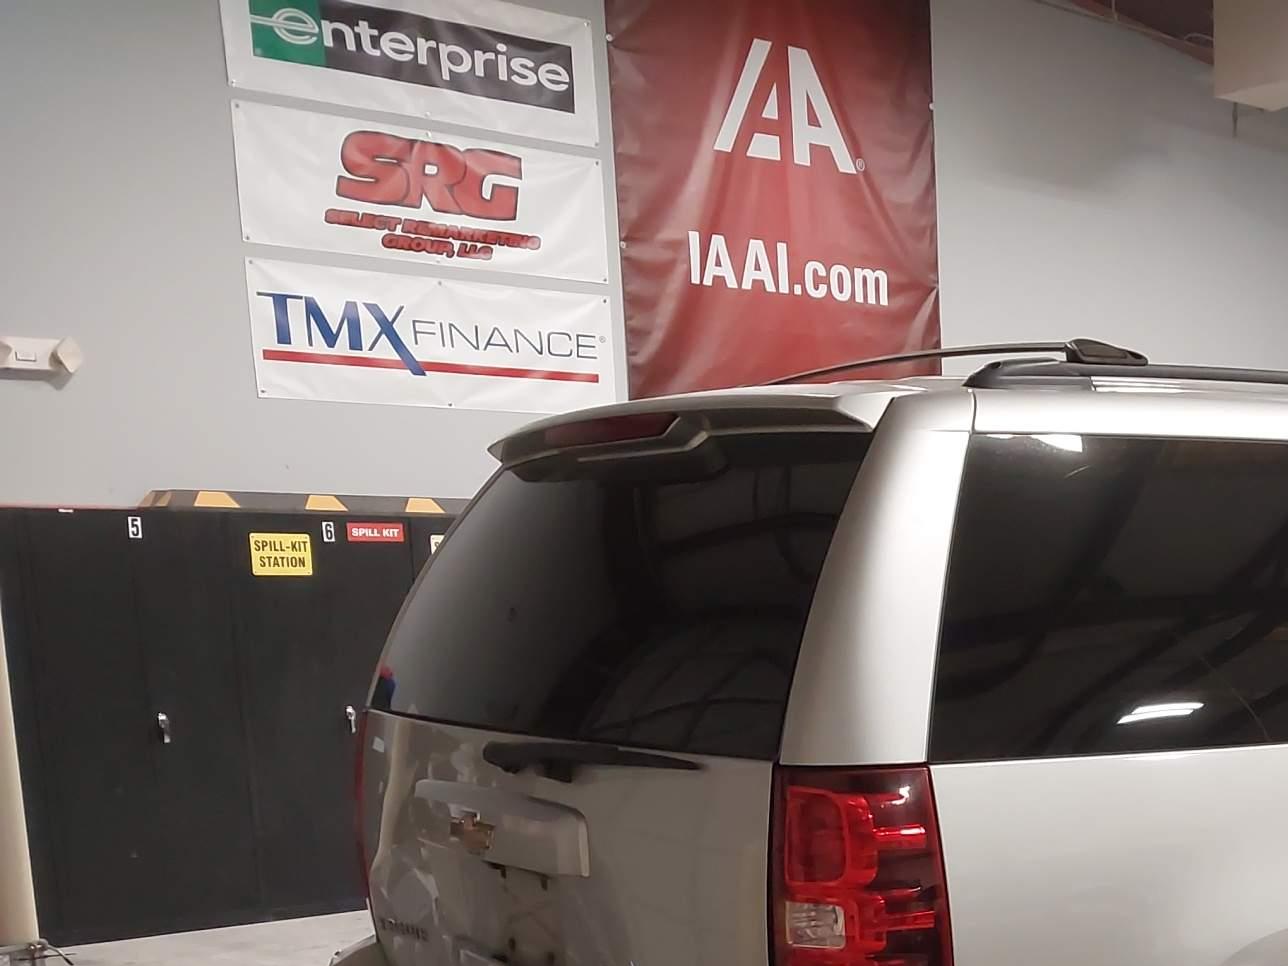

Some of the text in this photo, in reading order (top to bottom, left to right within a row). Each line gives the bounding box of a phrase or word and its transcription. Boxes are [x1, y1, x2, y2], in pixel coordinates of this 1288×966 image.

[250, 6, 571, 93] enterprise
[336, 130, 522, 220] SRG
[688, 230, 889, 306] IAAI.com
[256, 292, 426, 376] TMX
[130, 518, 140, 537] 5
[324, 524, 334, 540] 6
[351, 528, 400, 538] SPILL KIT
[254, 540, 308, 553] SPILL-KIT
[259, 555, 306, 569] STATION
